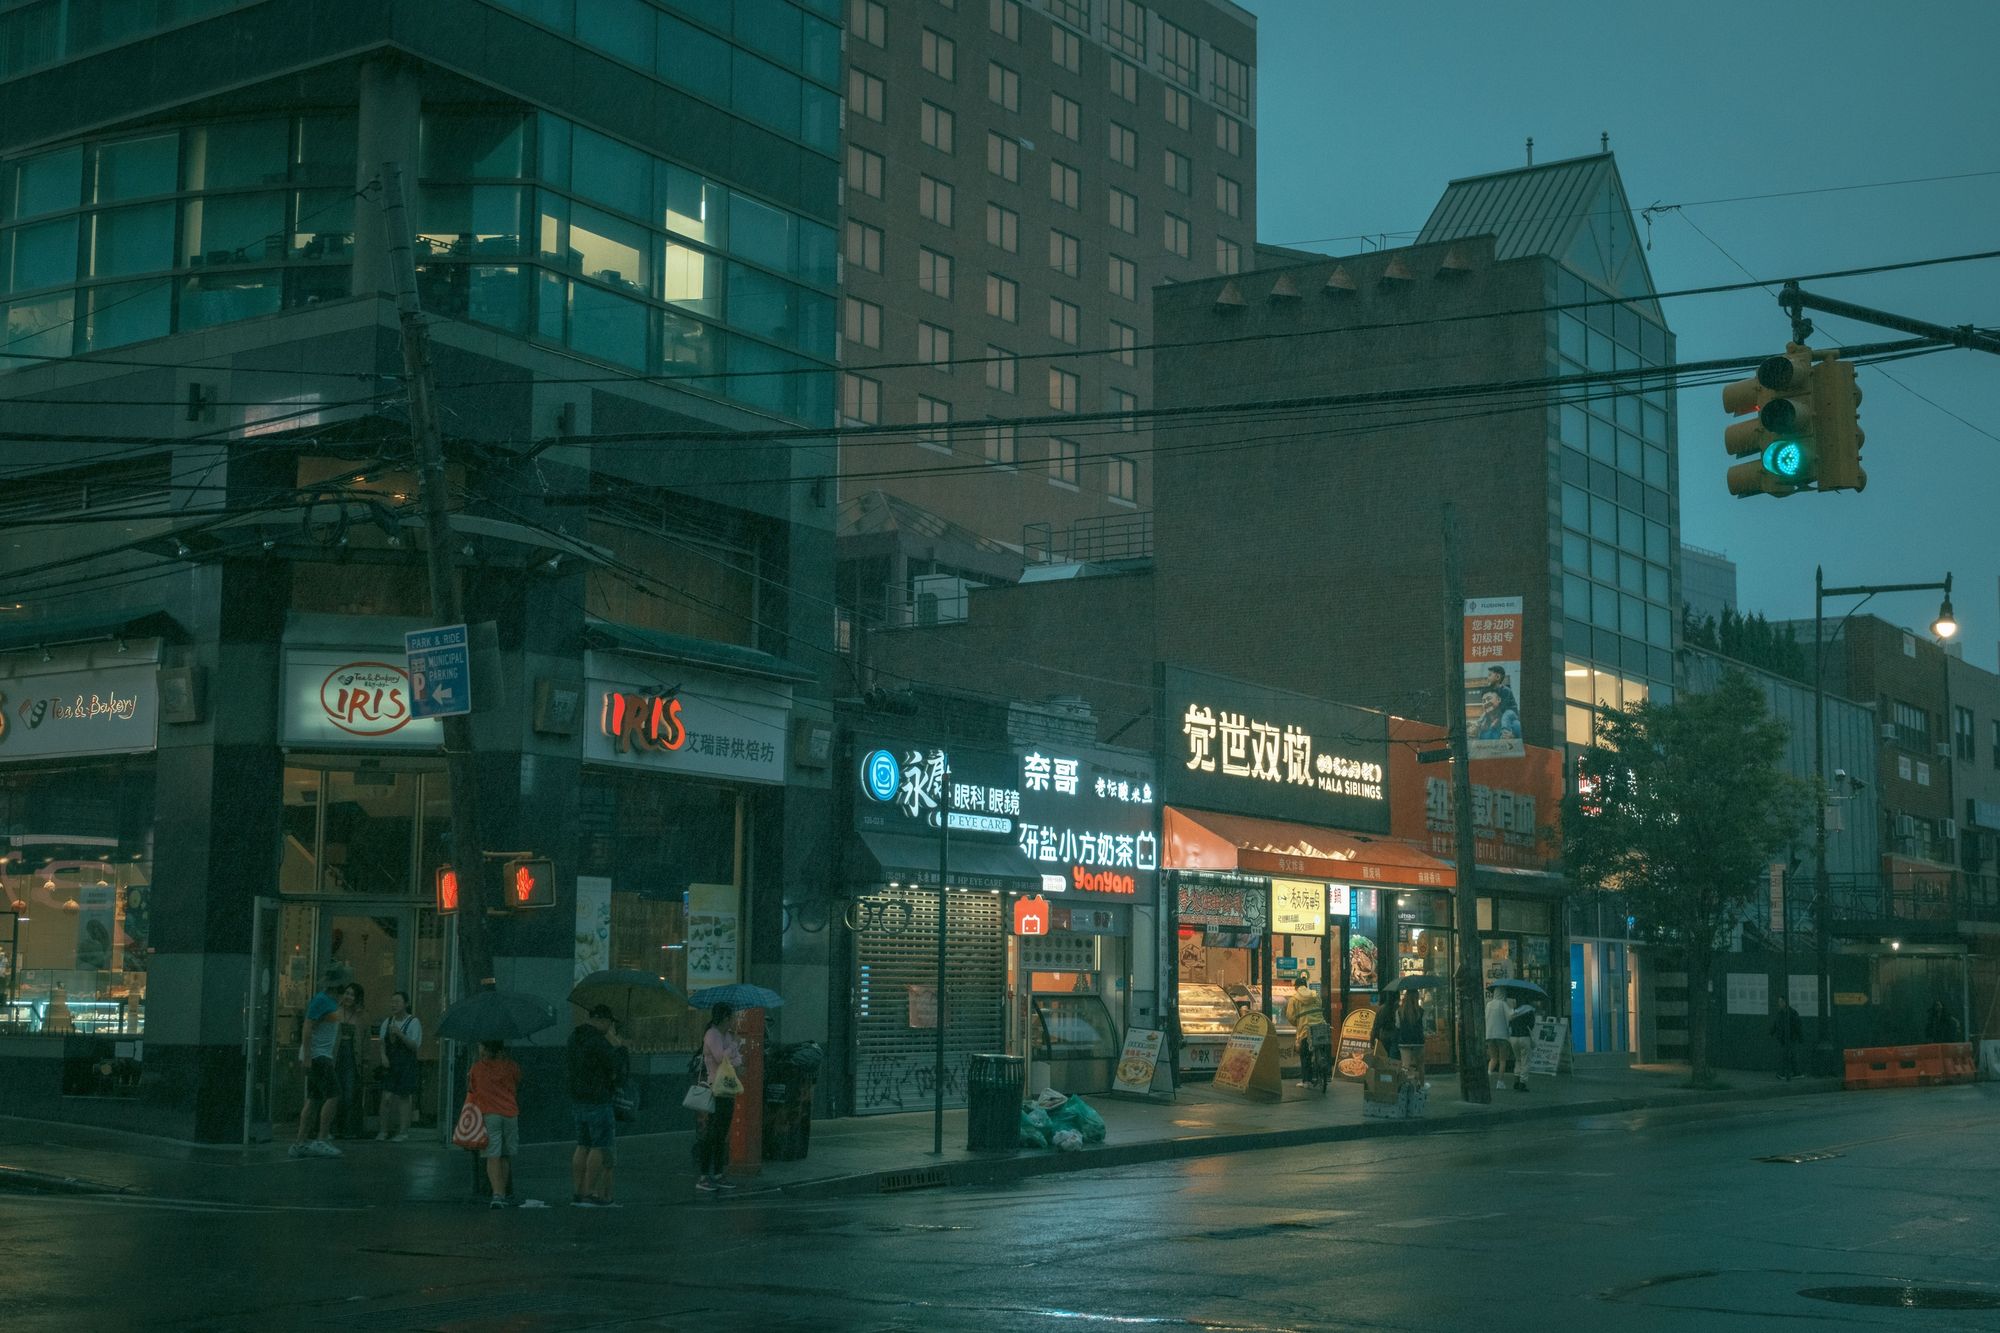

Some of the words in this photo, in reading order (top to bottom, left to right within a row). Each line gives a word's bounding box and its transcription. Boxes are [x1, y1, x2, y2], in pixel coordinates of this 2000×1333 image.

[411, 638, 431, 649] PARK
[434, 636, 442, 646] &
[443, 632, 461, 644] RIDE
[428, 652, 464, 668] MUNICIPAL
[429, 667, 458, 681] PARKING
[50, 698, 73, 719] Tea
[89, 691, 137, 721] Bakery
[337, 687, 405, 724] IRIS
[602, 692, 686, 754] IRIS
[685, 731, 775, 763] 艾瑞詩烘焙坊
[1023, 751, 1080, 796] 奈哥
[1318, 777, 1343, 793] MALA
[953, 782, 986, 811] 眼科
[988, 787, 1020, 816] 眼鏡
[958, 815, 978, 828] EYE
[980, 817, 1008, 831] CARE
[1474, 842, 1497, 862] IGITAL
